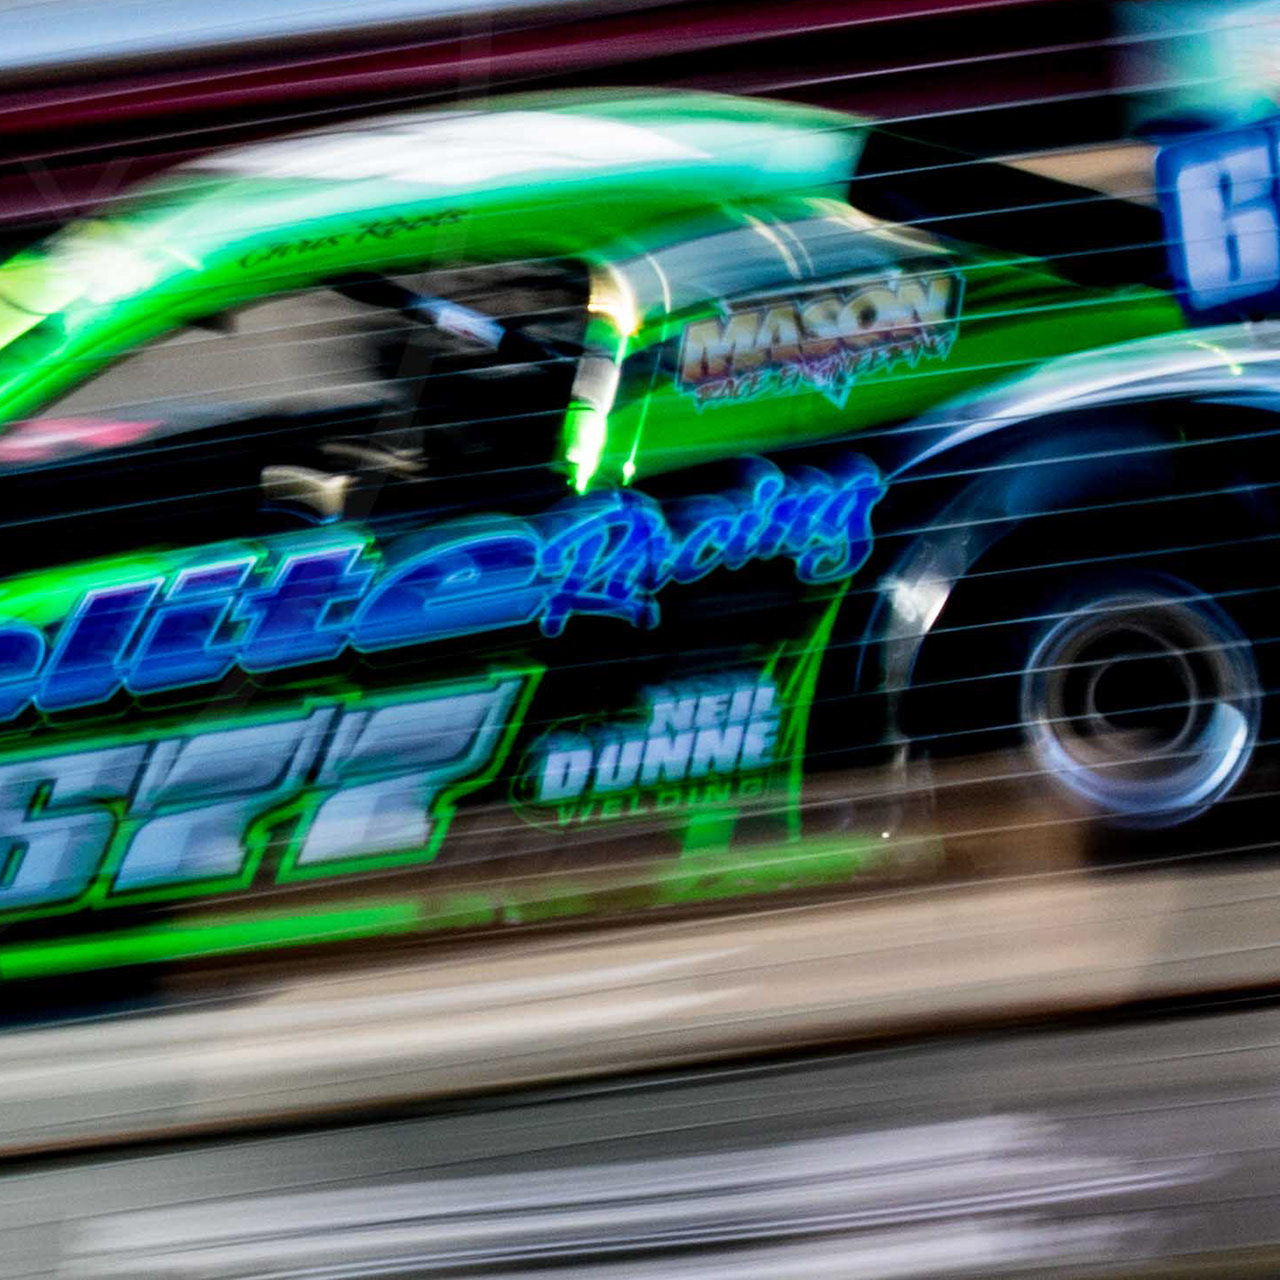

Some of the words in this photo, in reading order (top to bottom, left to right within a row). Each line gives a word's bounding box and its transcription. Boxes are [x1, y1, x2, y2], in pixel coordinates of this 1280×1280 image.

[1178, 144, 1280, 310] 6
[678, 273, 955, 386] MASON
[538, 468, 888, 638] Racing
[538, 719, 780, 804] DUNNE
[648, 684, 777, 735] NEIL
